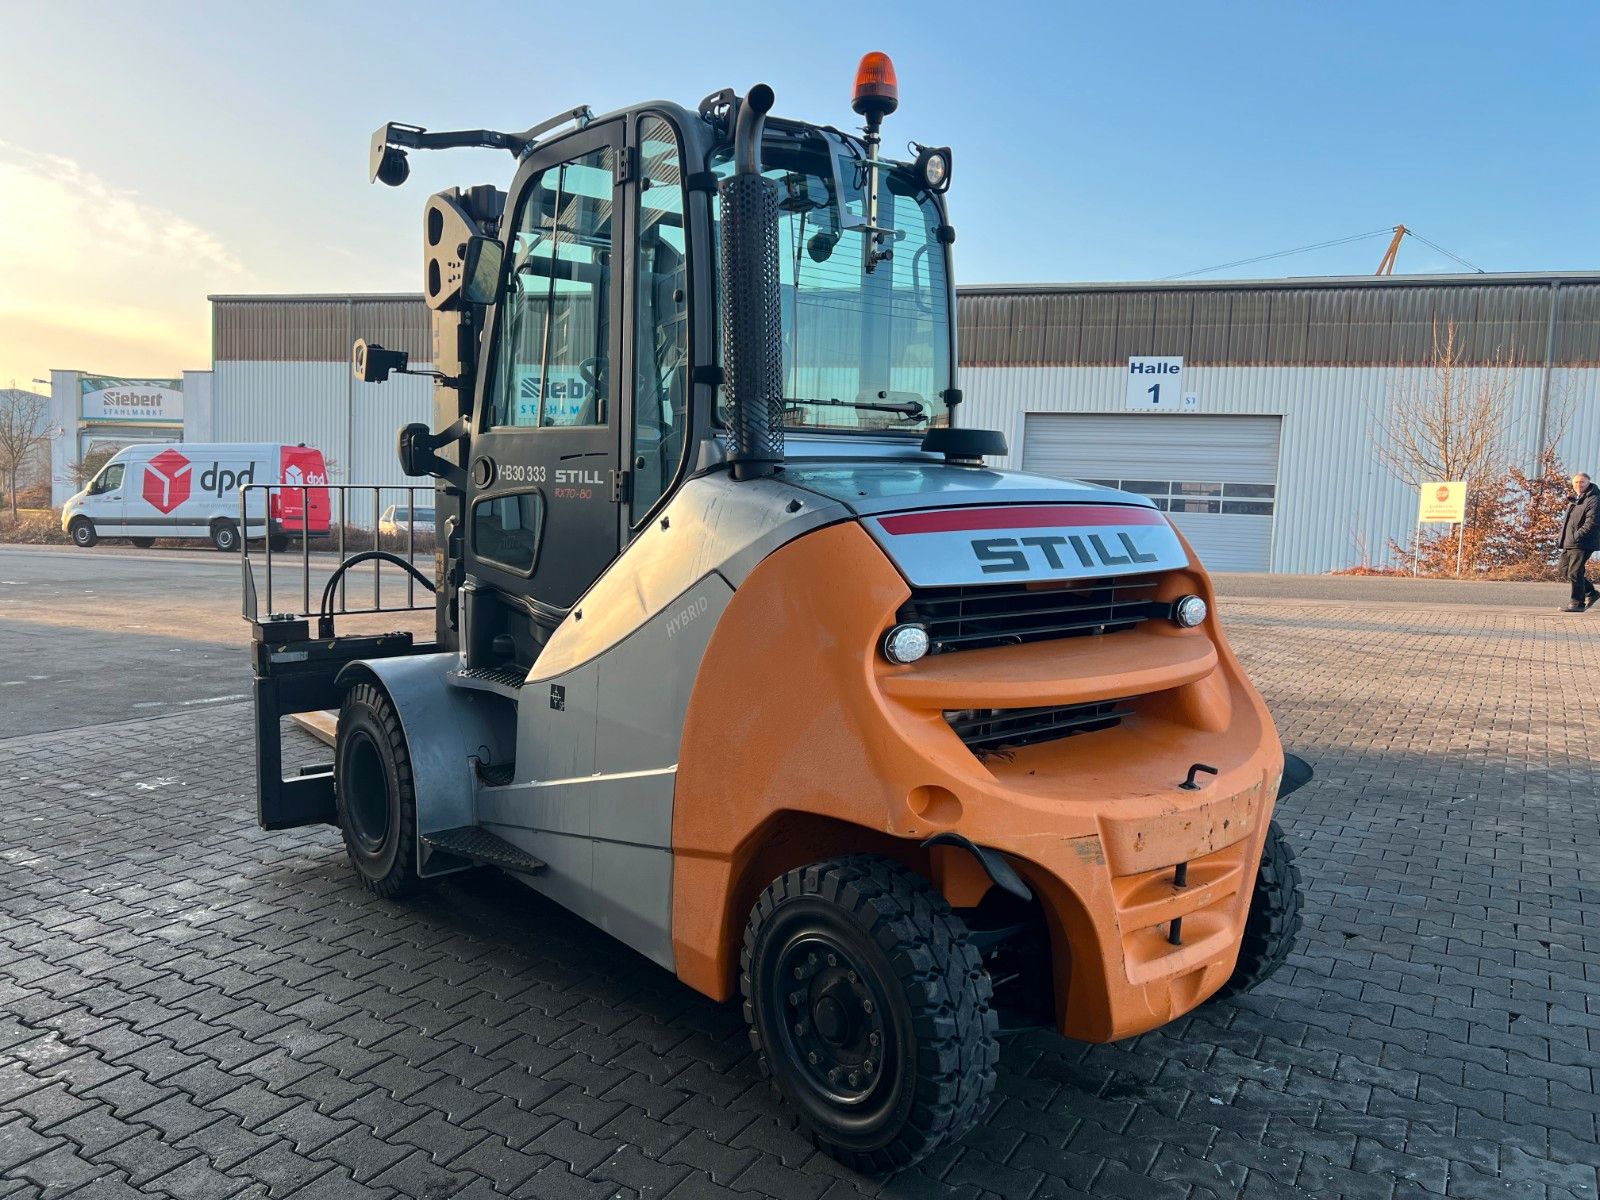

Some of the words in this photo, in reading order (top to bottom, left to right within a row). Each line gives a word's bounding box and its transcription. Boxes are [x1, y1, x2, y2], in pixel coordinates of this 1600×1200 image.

[1130, 362, 1180, 374] Halle
[103, 391, 163, 407] Siebert
[1147, 383, 1161, 404] 1
[200, 461, 255, 498] dpd
[306, 471, 324, 485] dpd
[526, 465, 547, 483] 333
[555, 469, 604, 484] STILL
[970, 532, 1159, 574] STILL
[665, 596, 708, 640] HYBRID
